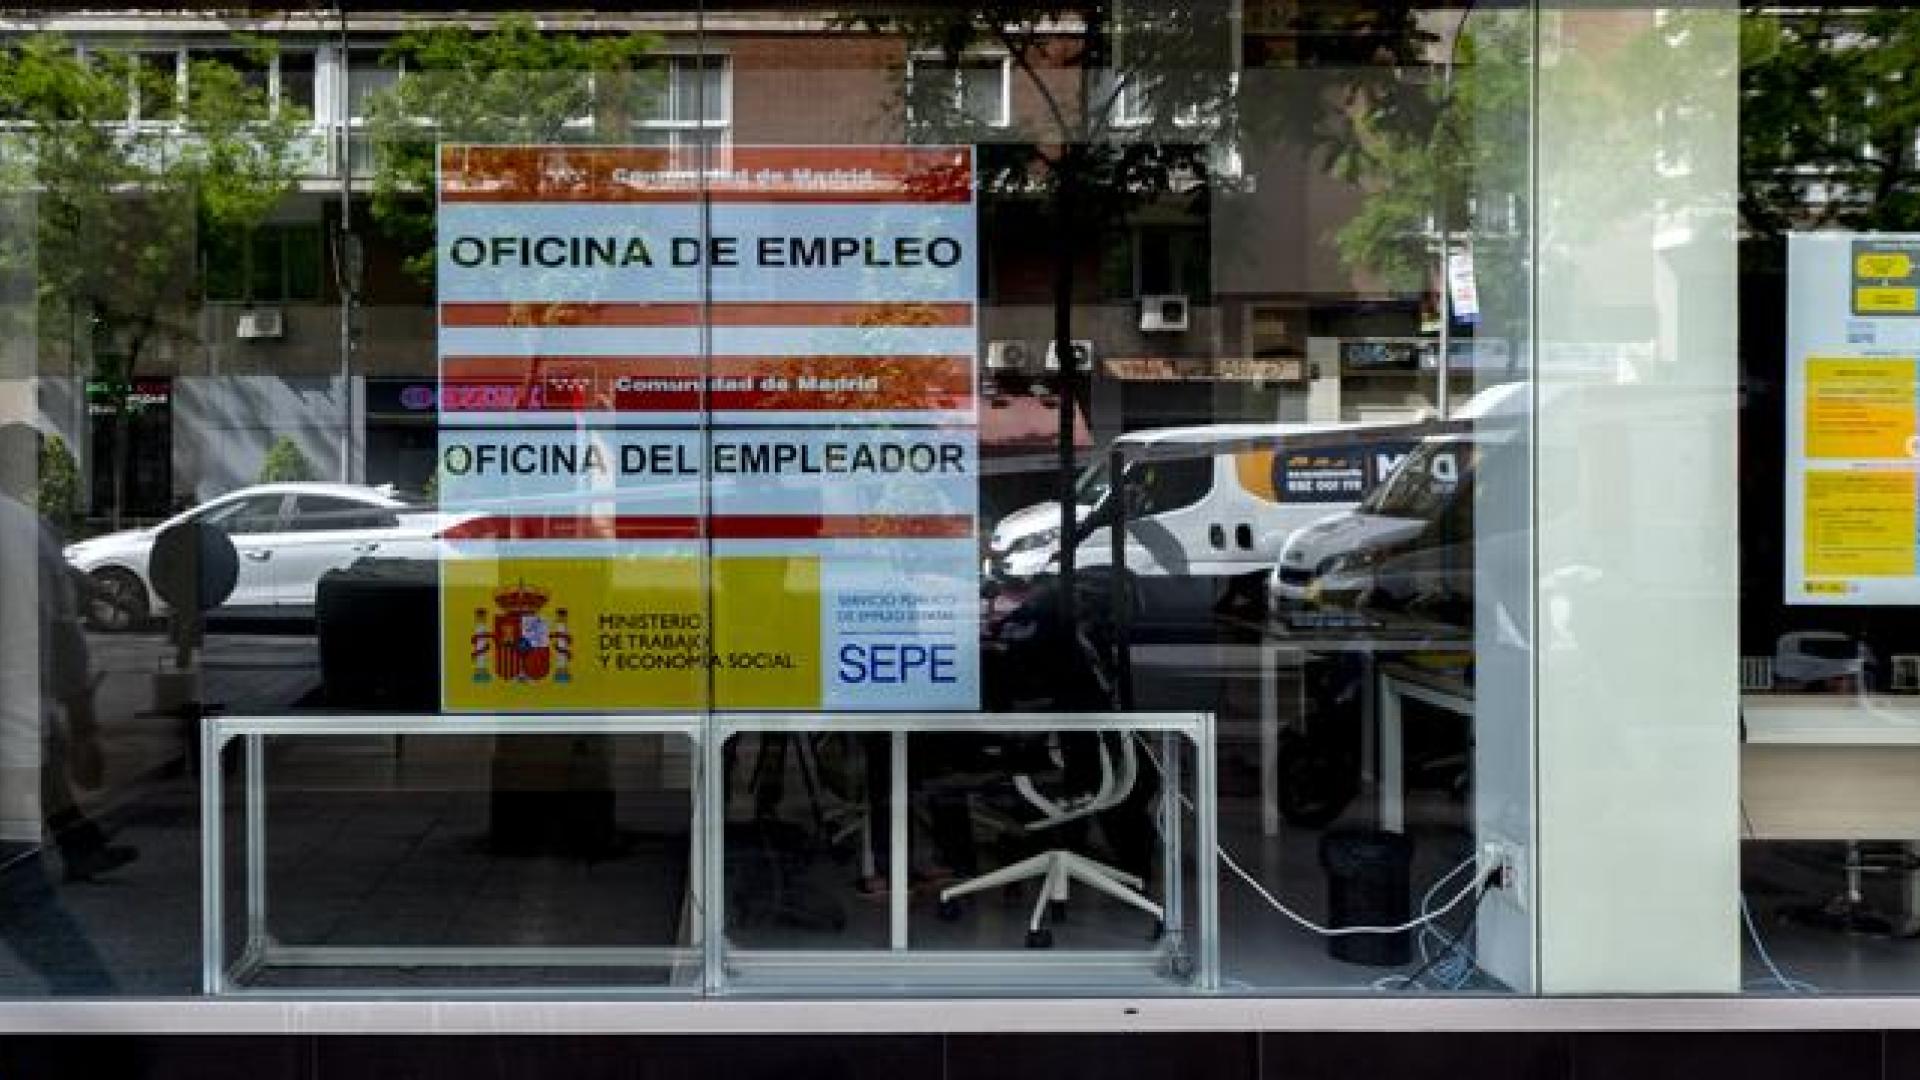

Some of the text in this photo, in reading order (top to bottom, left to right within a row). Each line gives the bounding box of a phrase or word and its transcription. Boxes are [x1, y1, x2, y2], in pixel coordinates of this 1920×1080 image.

[450, 236, 963, 268] OFICINA DE EMPLEO
[760, 376, 788, 391] de
[798, 375, 878, 391] Madrid
[443, 444, 965, 475] OFICINA DEL EMPLEADOR
[599, 613, 702, 629] MINISTERIO
[600, 634, 622, 650] DE
[599, 655, 610, 669] Y
[729, 654, 794, 669] SOCIAL
[839, 643, 957, 684] SEPE
